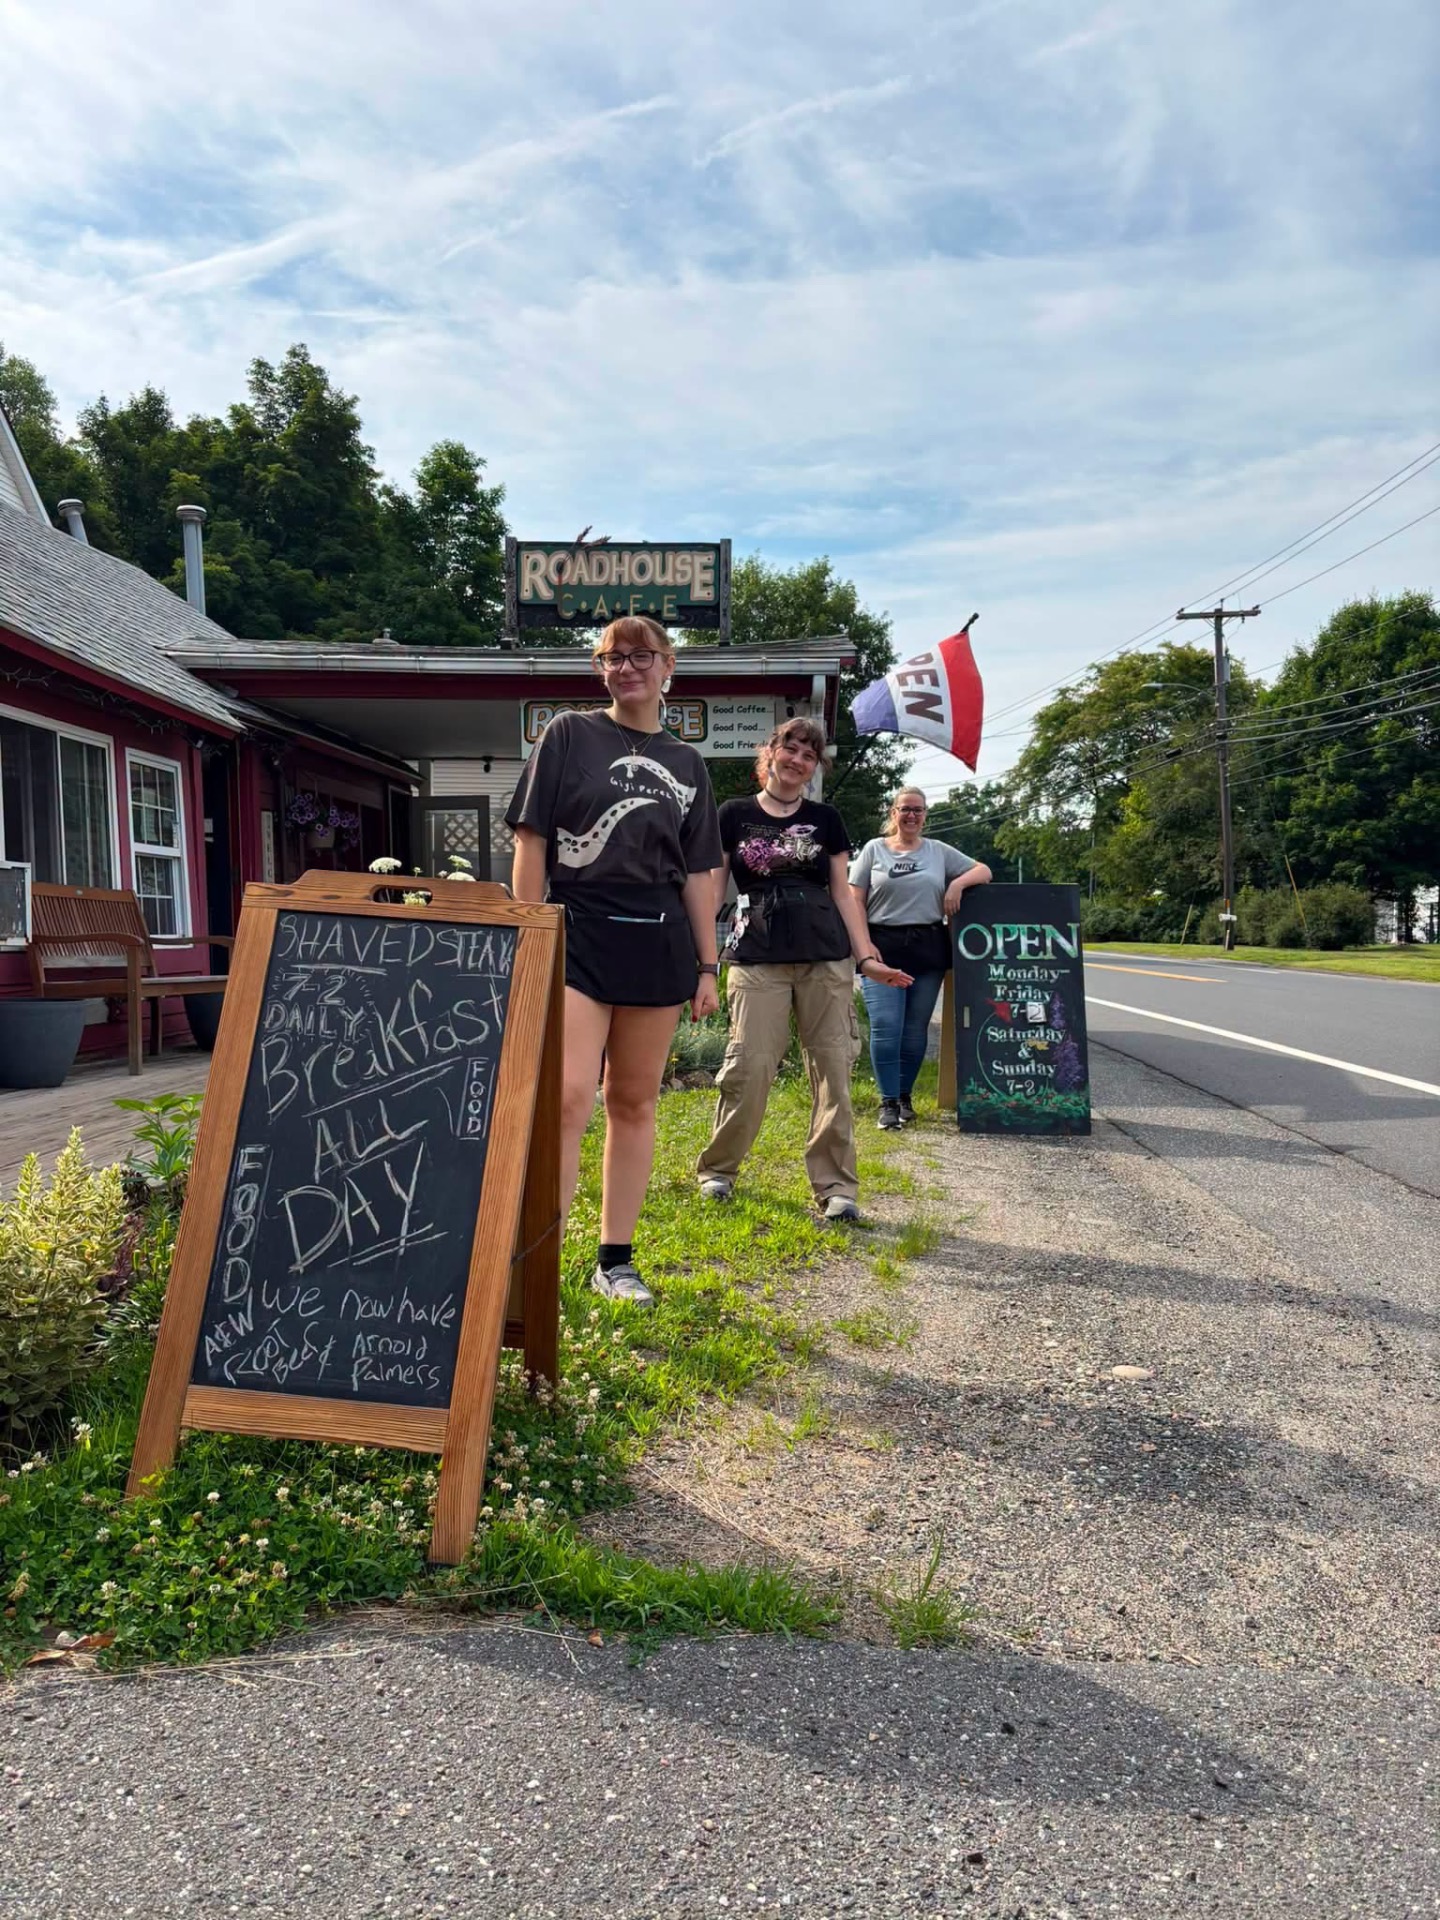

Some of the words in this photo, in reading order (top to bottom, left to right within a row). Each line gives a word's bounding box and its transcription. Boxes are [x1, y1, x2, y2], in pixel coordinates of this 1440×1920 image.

[521, 551, 715, 601] ROADHOUSE
[896, 652, 945, 725] PEN
[712, 705, 734, 714] Good
[712, 722, 734, 732] Good
[712, 740, 734, 750] Good
[278, 914, 434, 966] SHAVED
[957, 923, 1081, 961] OPEN
[282, 972, 346, 1006] 7-2
[994, 984, 1054, 1004] Friday
[264, 1000, 368, 1042] DAILY
[987, 1025, 1065, 1045] Saturday
[1018, 1041, 1034, 1059] &
[992, 1060, 1057, 1078] Sunday
[466, 1060, 486, 1135] FOOD
[1006, 1079, 1036, 1097] 7-2
[315, 1098, 430, 1184] ALL
[222, 1144, 269, 1303] FOOD
[277, 1141, 425, 1274] DAY
[352, 1331, 427, 1361] Arnold
[351, 1357, 441, 1391] Palmers
